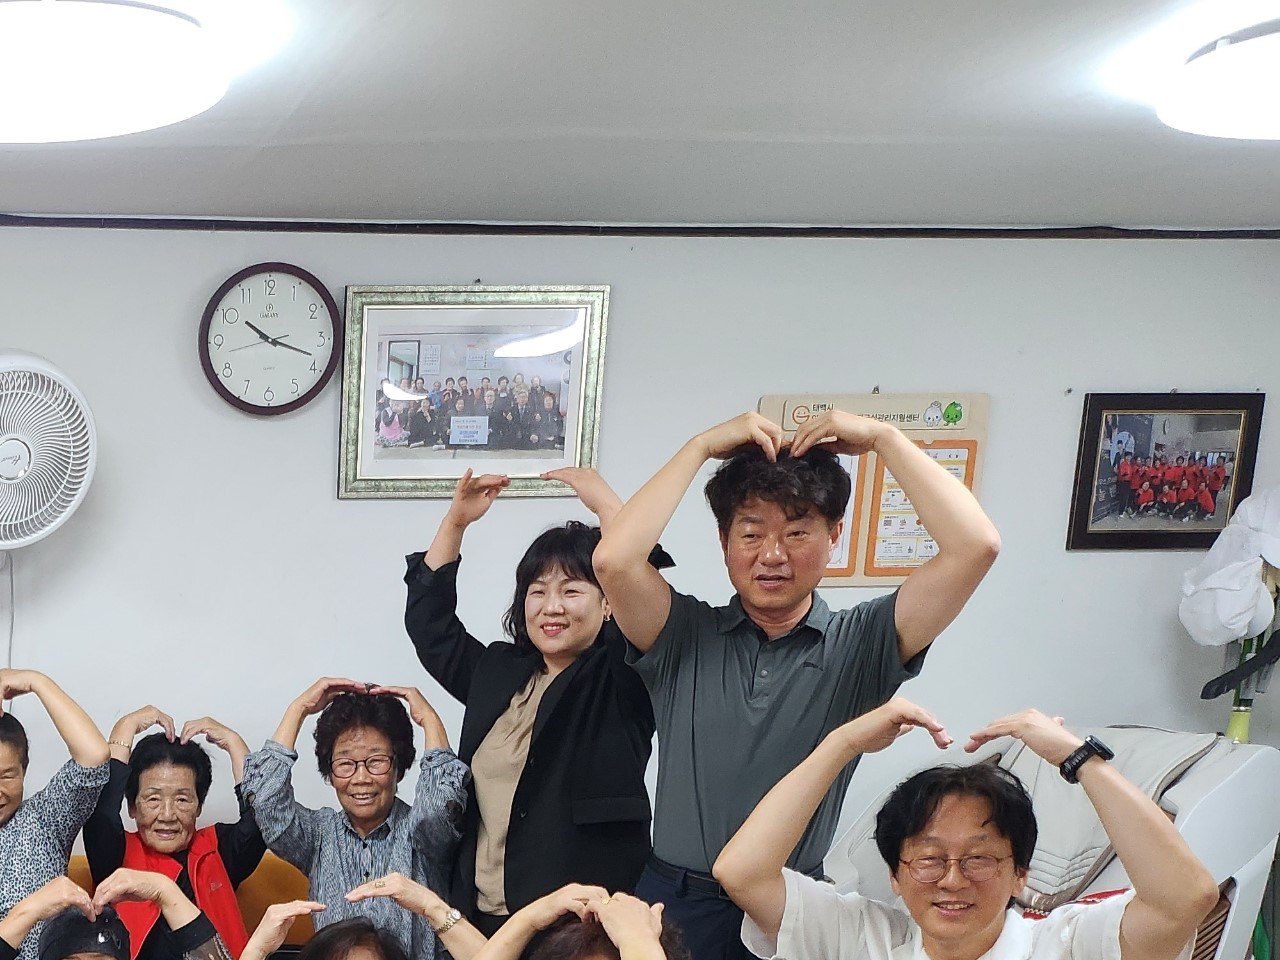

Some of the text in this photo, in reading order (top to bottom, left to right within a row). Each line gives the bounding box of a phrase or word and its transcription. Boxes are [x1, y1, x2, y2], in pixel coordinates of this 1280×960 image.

[264, 279, 276, 295] 12
[241, 288, 251, 304] 11
[222, 307, 239, 324] 10
[308, 303, 318, 319] 2
[213, 333, 224, 350] 9
[317, 331, 326, 347] 3
[222, 362, 233, 378] 8
[309, 359, 318, 374] 4
[244, 379, 250, 395] 7
[263, 386, 274, 402] 6
[291, 378, 299, 394] 5
[812, 404, 834, 412] 태백시
